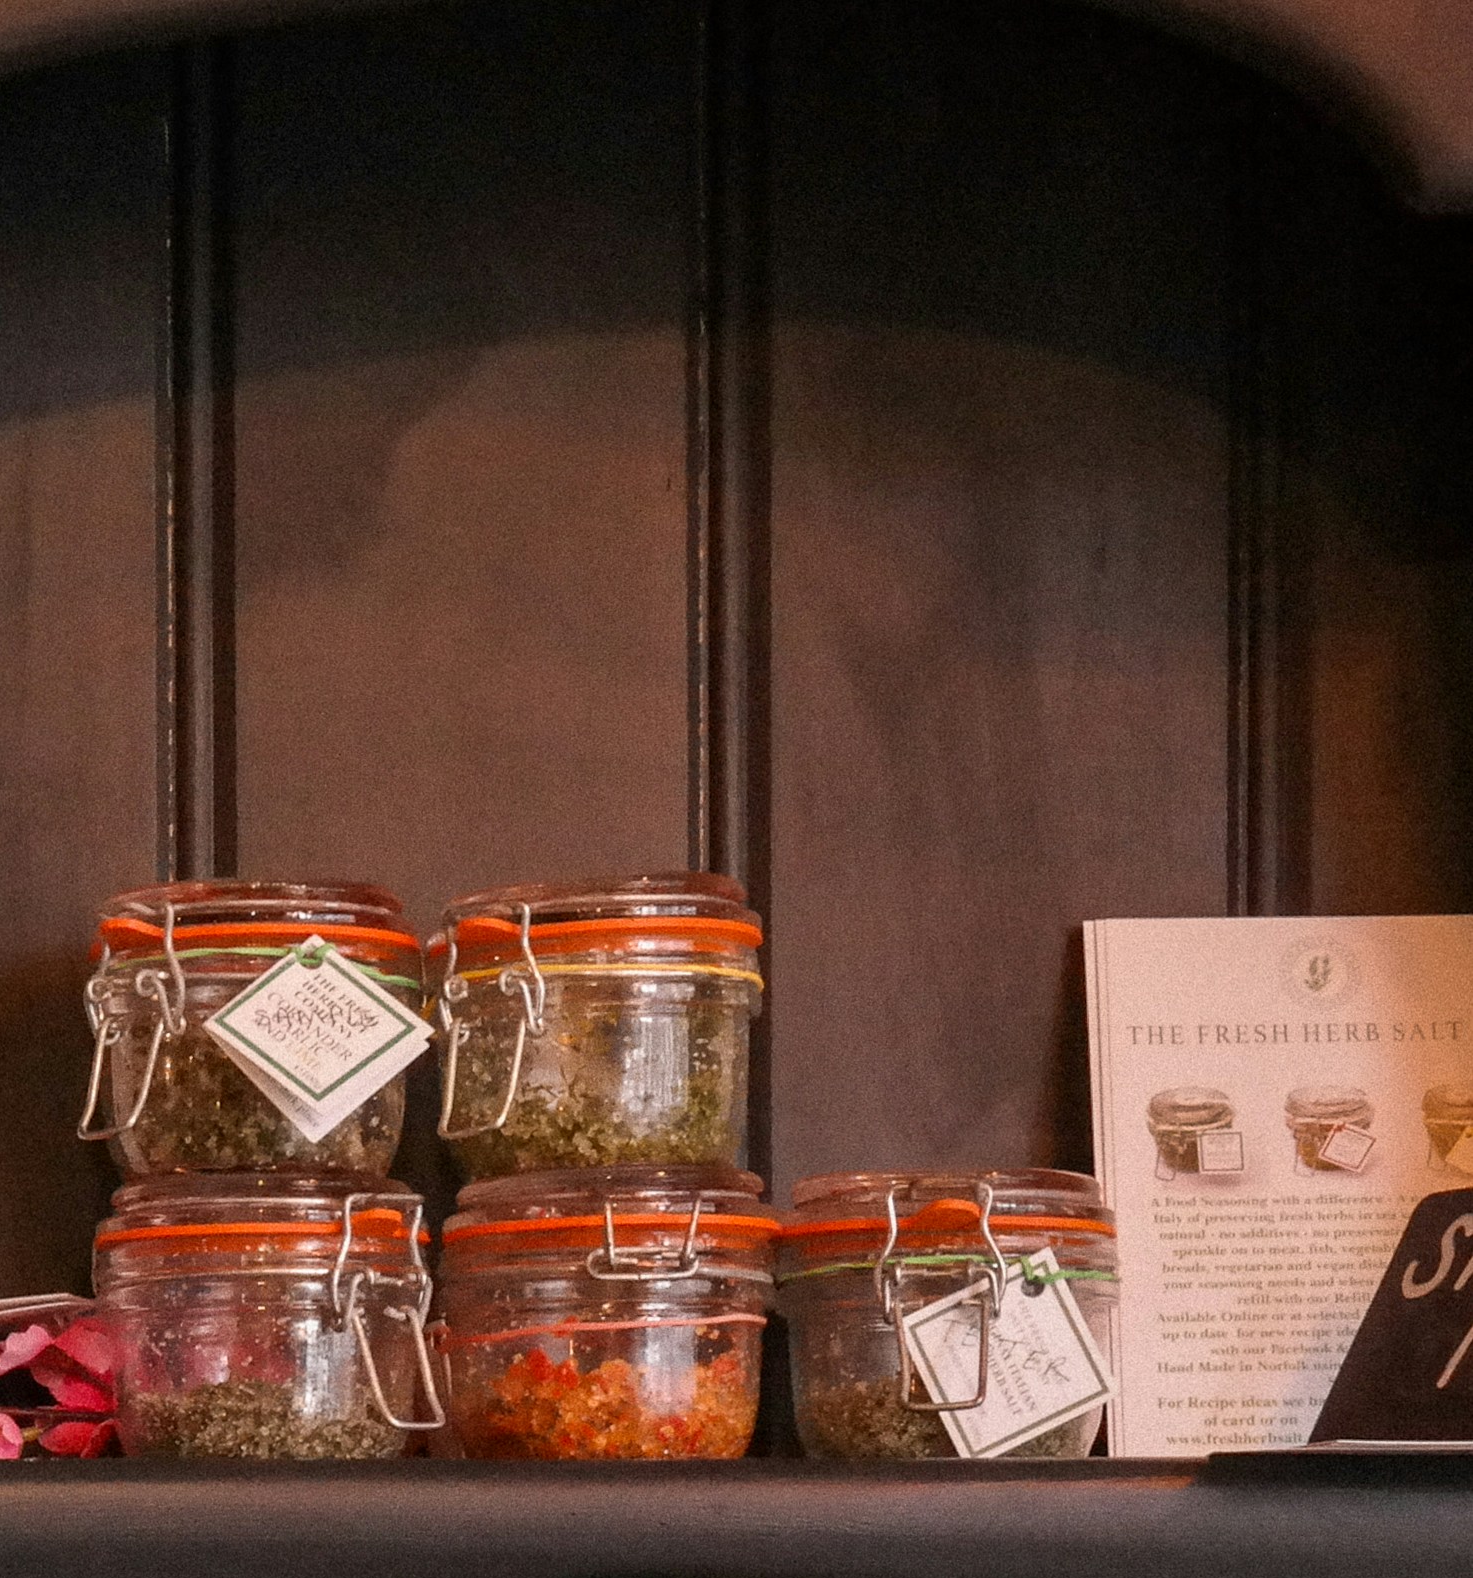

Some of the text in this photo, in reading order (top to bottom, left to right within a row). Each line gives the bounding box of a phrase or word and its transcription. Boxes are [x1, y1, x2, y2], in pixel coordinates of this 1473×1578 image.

[1127, 1021, 1464, 1045] THE FRESH HERB SALT
[1157, 1361, 1308, 1373] Hand Made in Norfolk
[1157, 1396, 1278, 1410] For Recipe ideas
